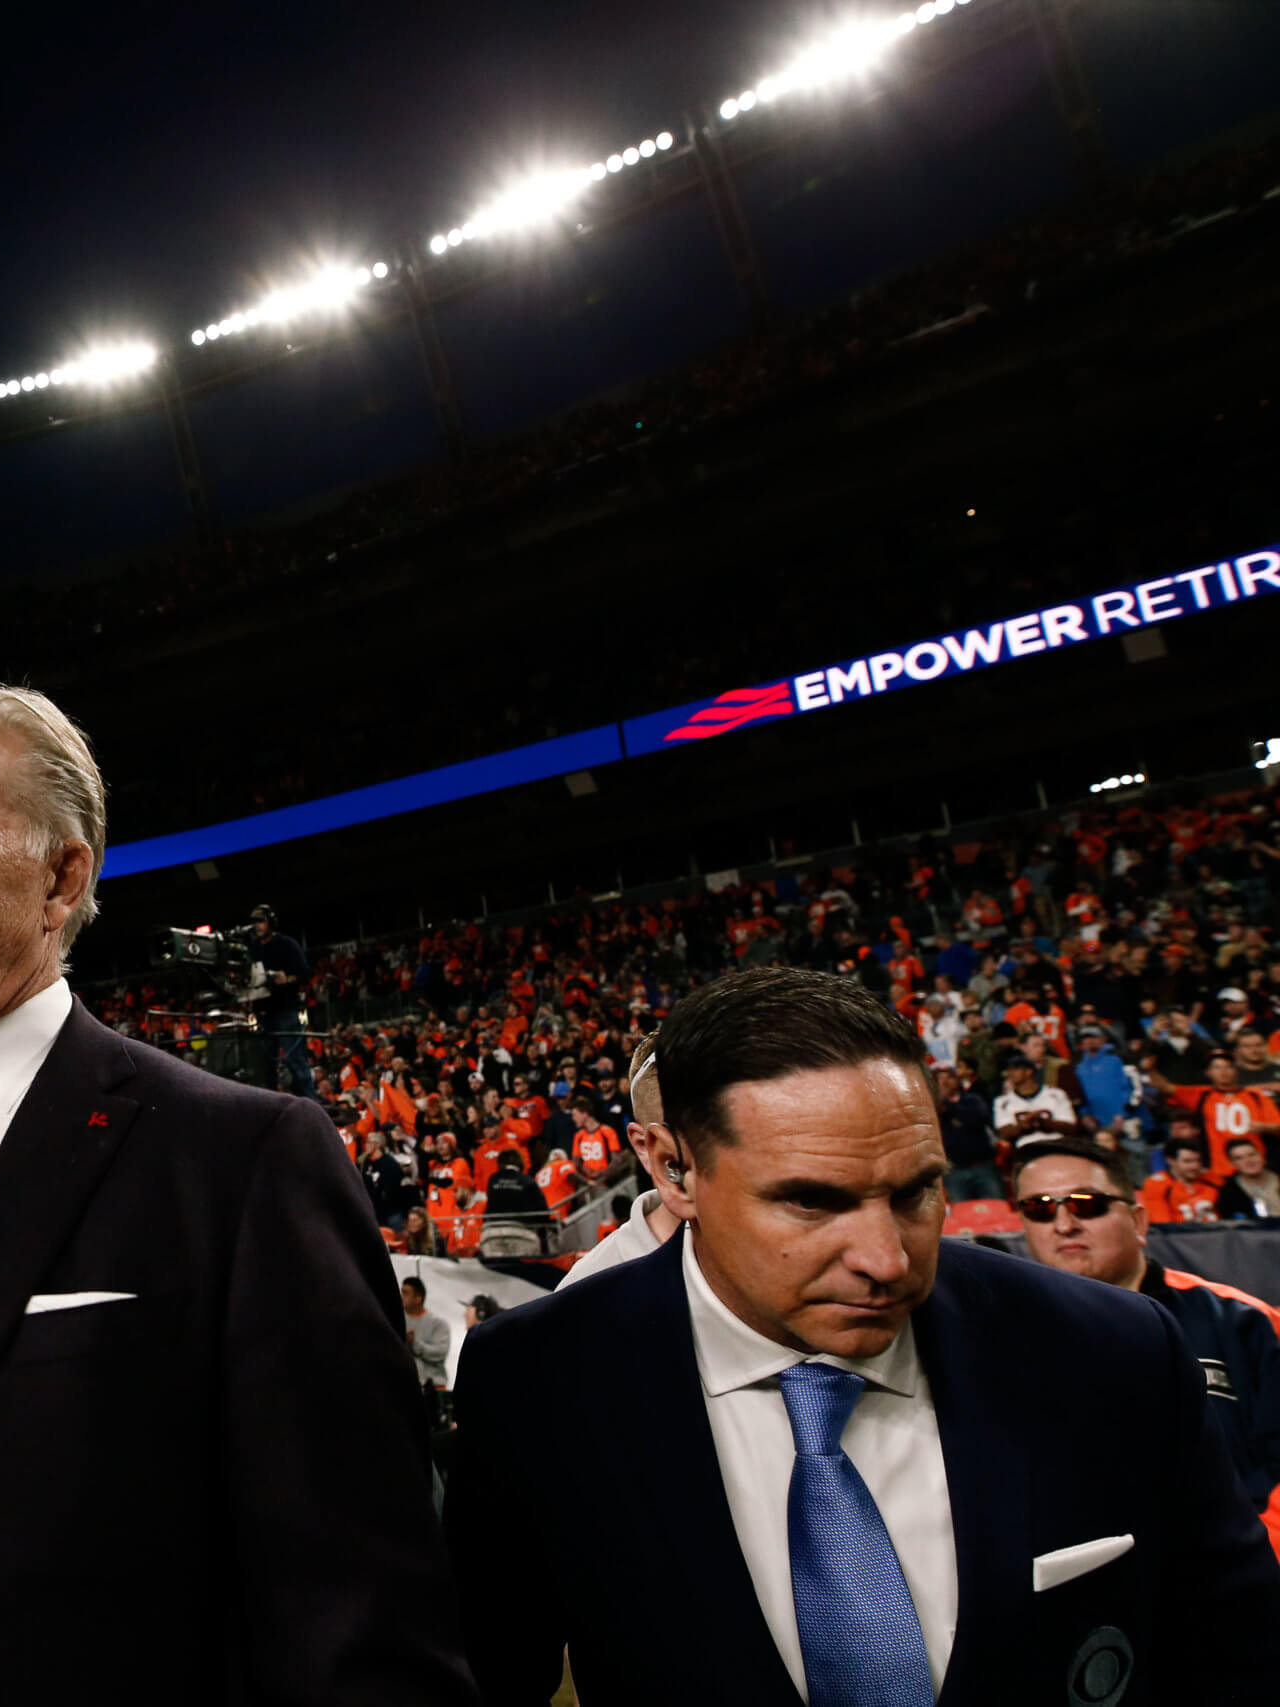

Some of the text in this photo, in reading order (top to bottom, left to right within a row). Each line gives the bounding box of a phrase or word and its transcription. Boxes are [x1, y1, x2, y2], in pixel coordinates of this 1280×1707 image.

[794, 551, 1280, 711] EMPOWER RETIR
[1215, 1102, 1251, 1135] 10
[580, 1141, 604, 1161] 58
